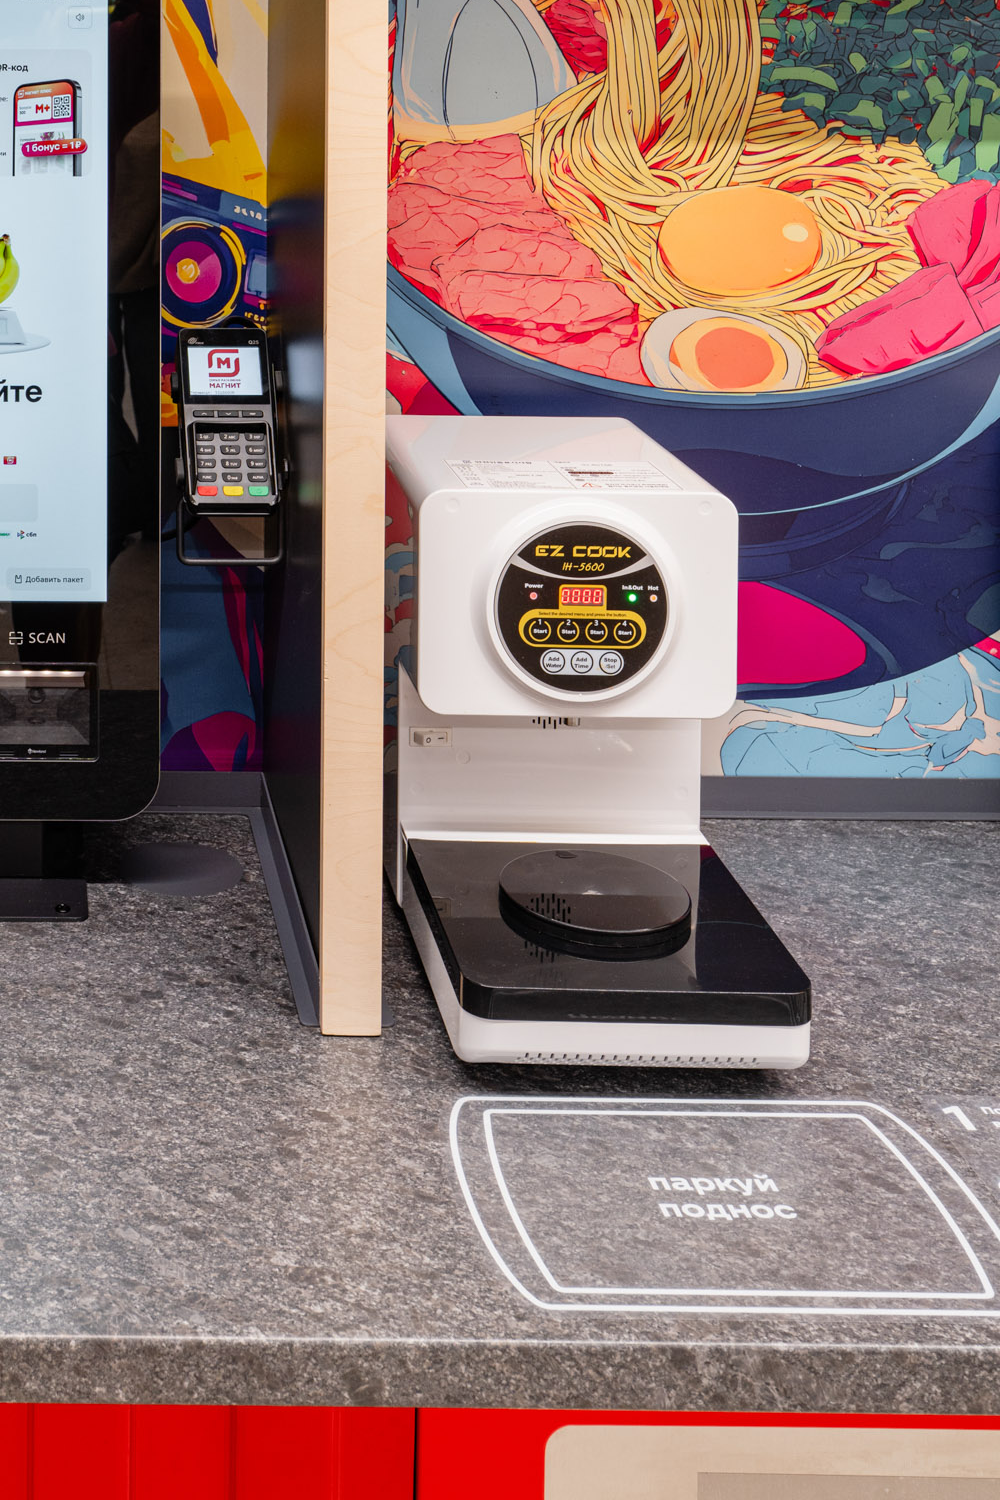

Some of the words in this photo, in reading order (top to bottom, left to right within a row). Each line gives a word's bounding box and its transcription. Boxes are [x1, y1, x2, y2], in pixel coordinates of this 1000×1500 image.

[31, 142, 60, 153] бонус
[535, 545, 565, 557] EZ
[572, 545, 631, 558] COOK
[562, 562, 605, 572] IH-5600
[25, 575, 61, 584] Добавить
[561, 588, 602, 604] 0000
[28, 632, 66, 645] SCAN
[942, 1105, 977, 1131] 1
[647, 1173, 779, 1198] паркуй
[658, 1201, 798, 1222] поднос
